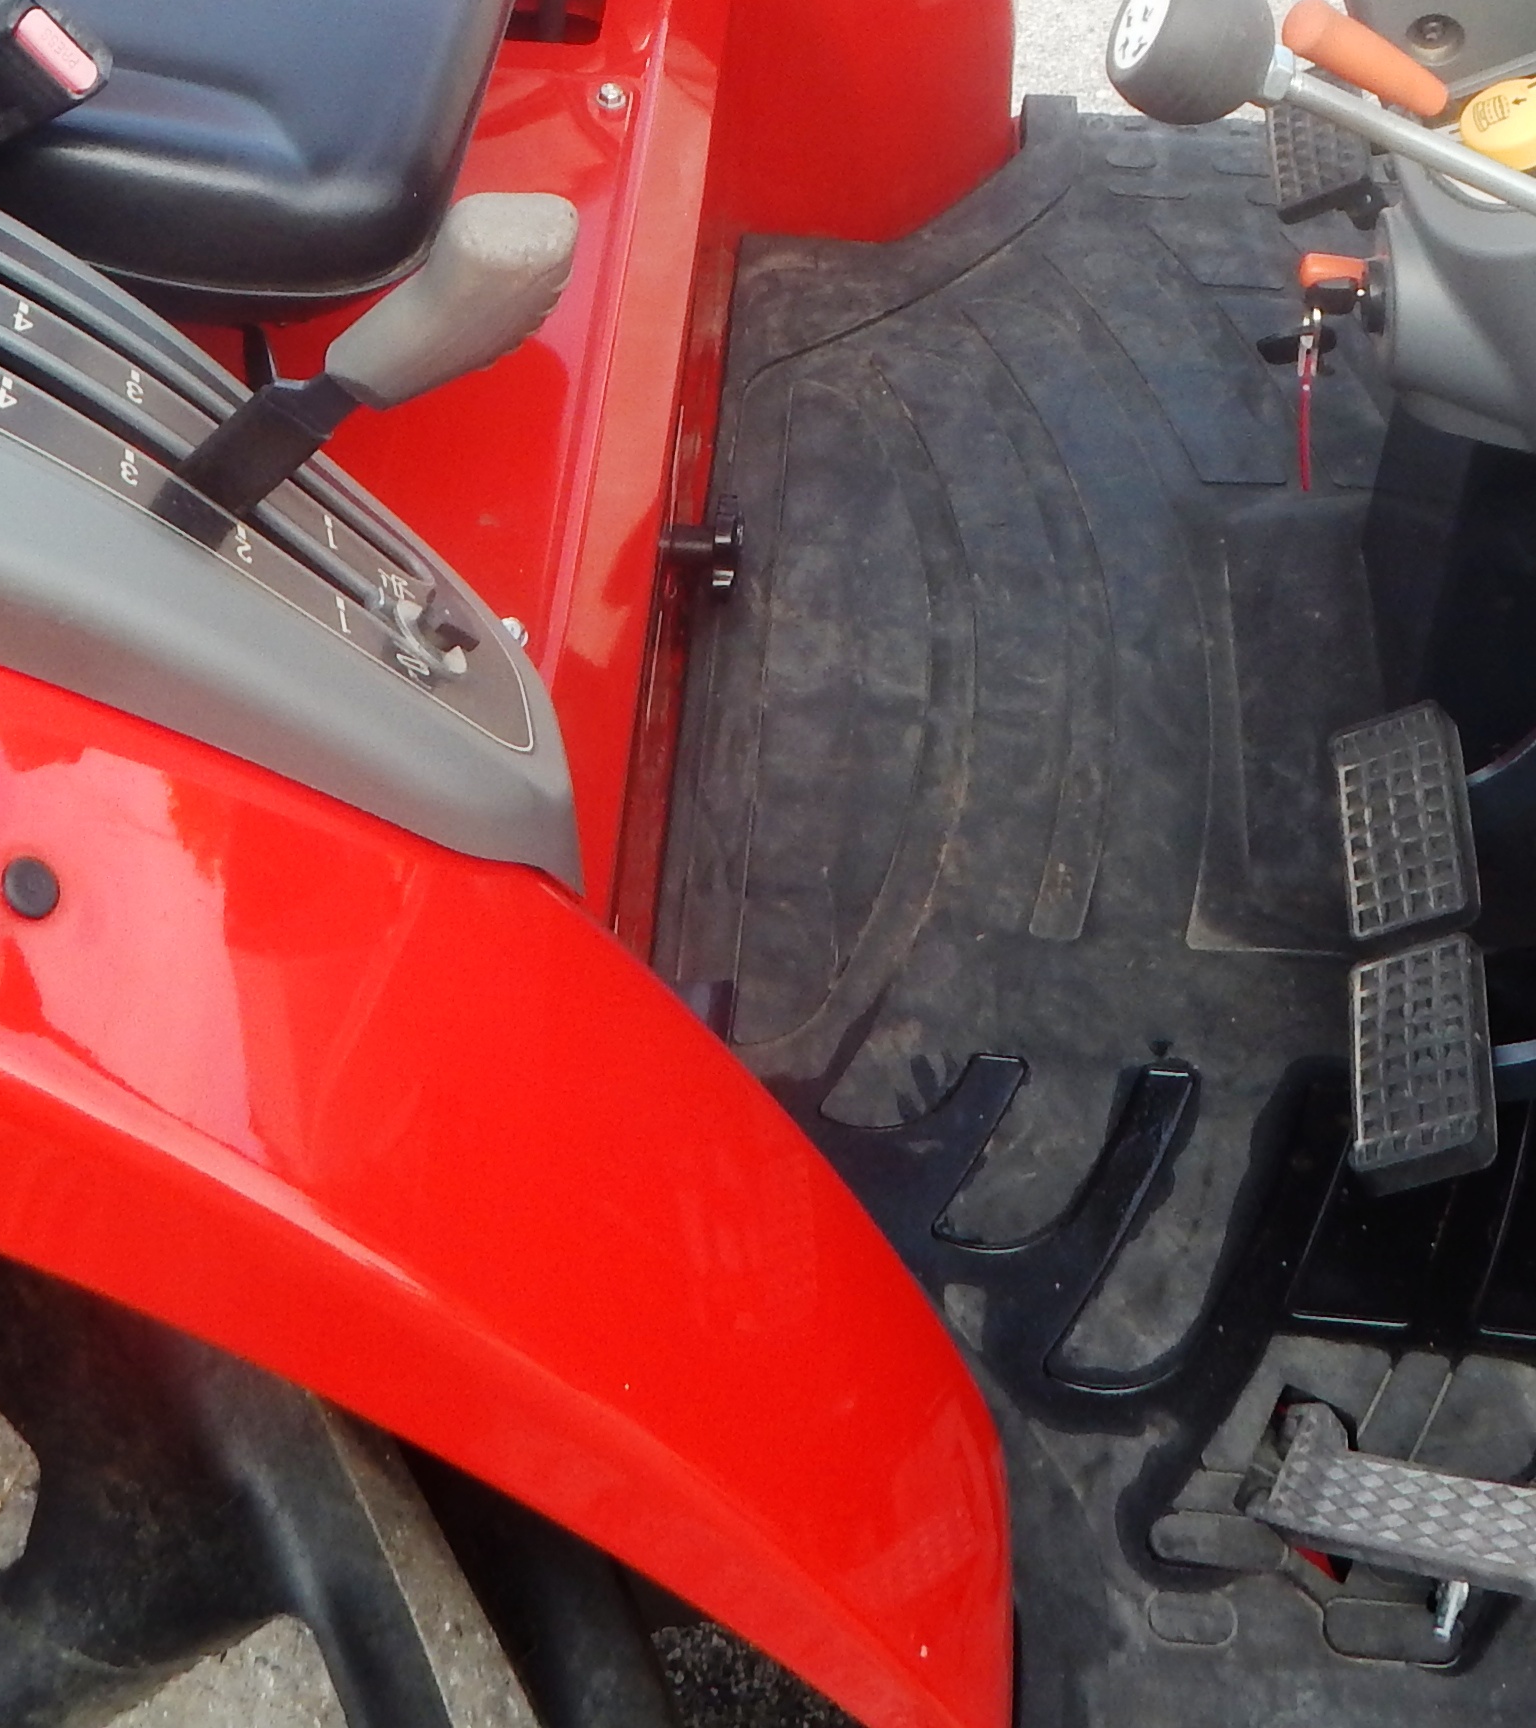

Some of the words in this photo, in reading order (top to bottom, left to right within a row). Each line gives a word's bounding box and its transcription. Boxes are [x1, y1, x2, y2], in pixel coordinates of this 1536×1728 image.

[11, 311, 34, 332] 4
[125, 380, 145, 405] 3
[119, 459, 139, 486] 3
[235, 534, 253, 564] 2
